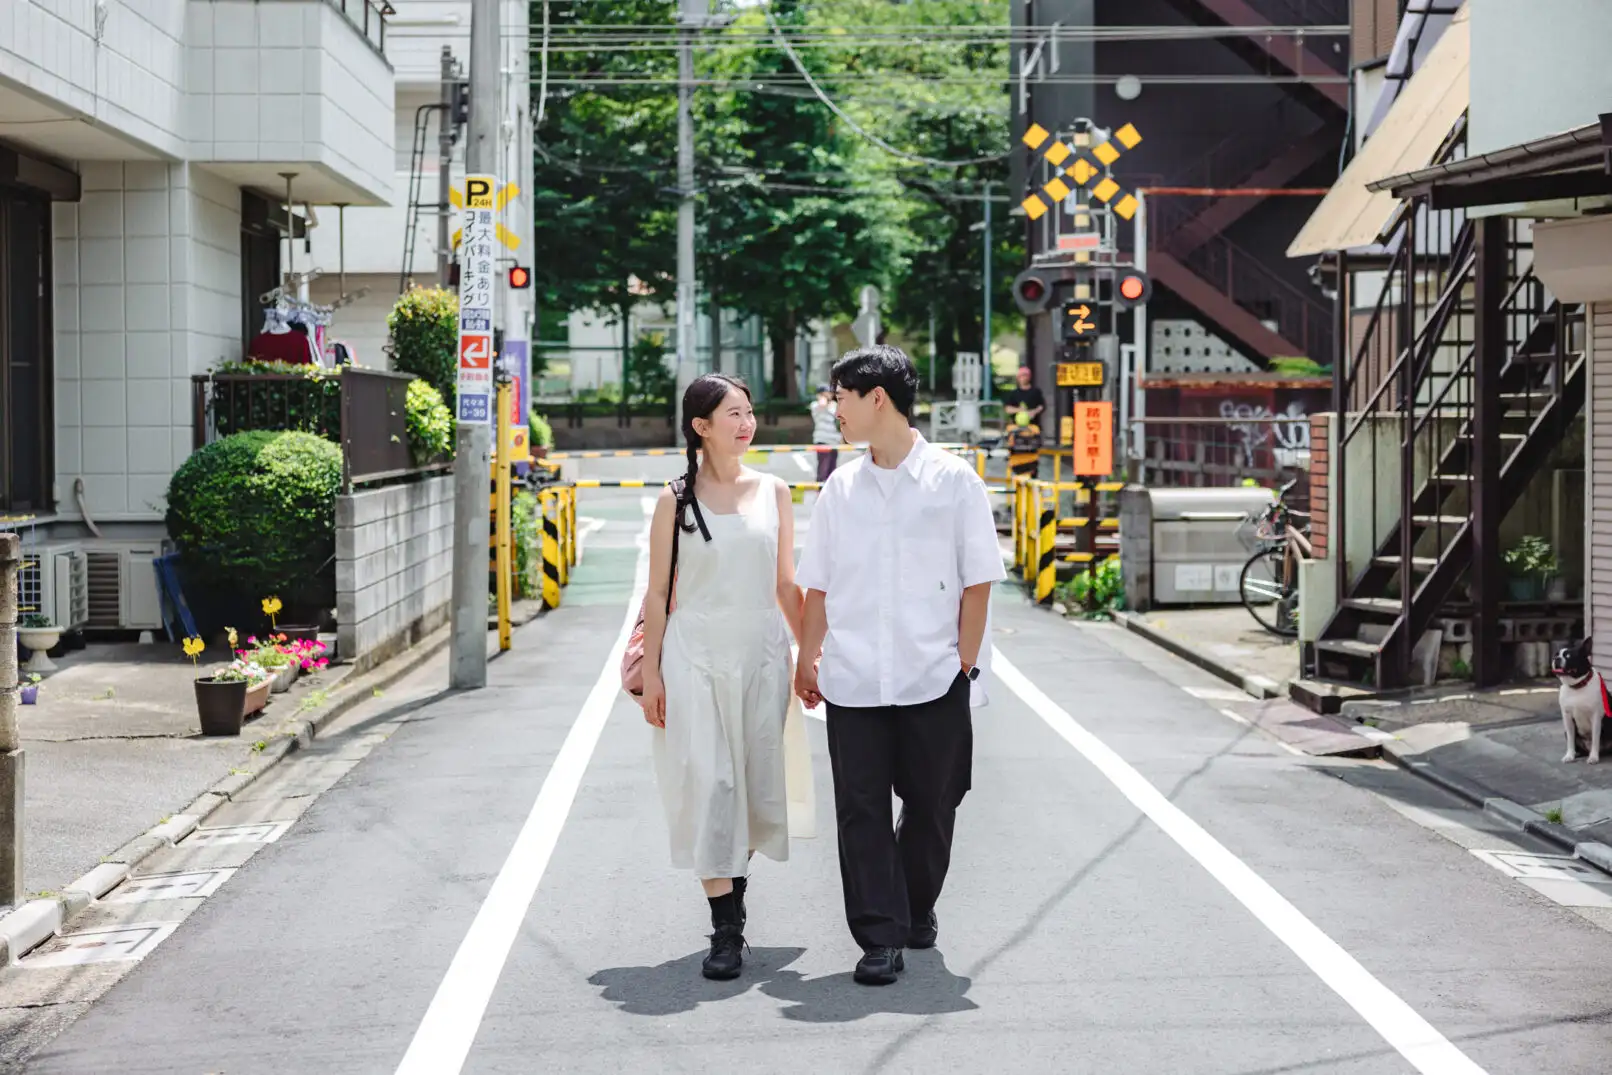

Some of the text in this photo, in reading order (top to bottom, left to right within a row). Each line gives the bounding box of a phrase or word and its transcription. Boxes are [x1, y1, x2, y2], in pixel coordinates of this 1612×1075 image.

[467, 180, 489, 206] P
[473, 198, 492, 207] 24H
[477, 211, 492, 306] 最大料金あり
